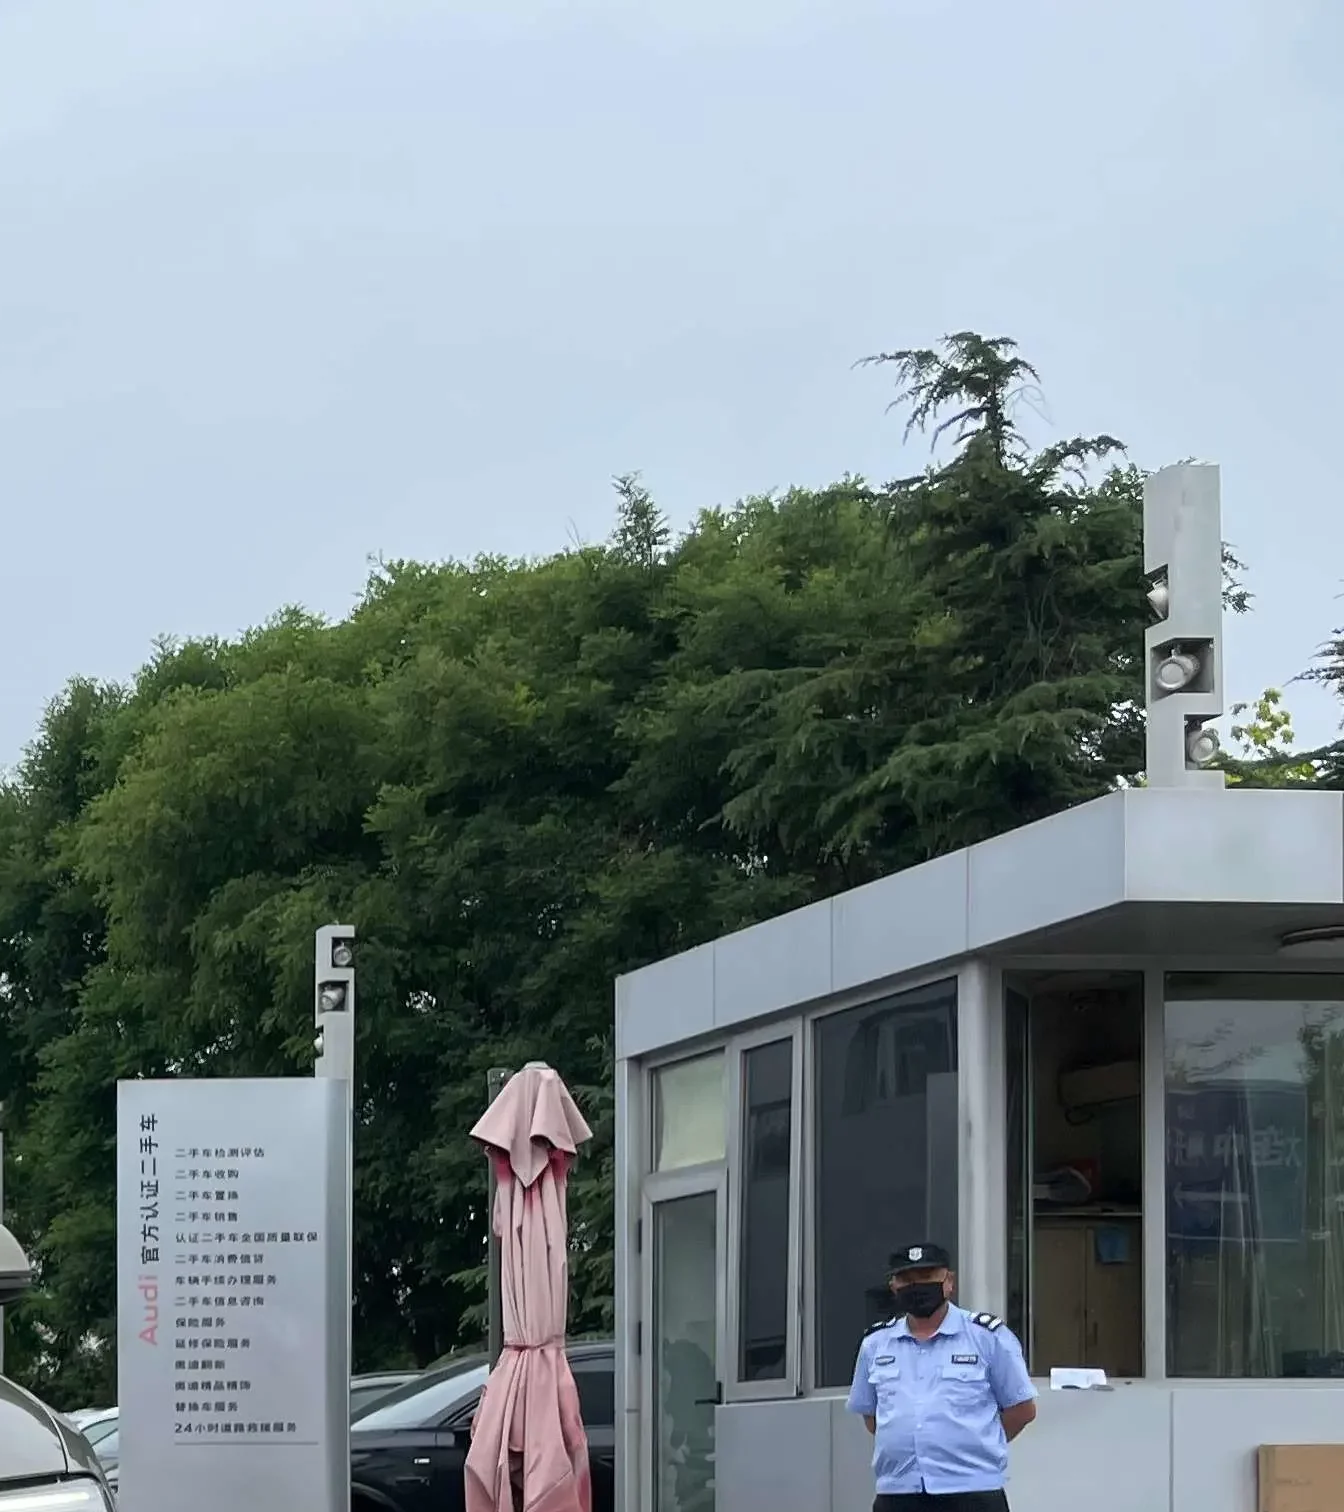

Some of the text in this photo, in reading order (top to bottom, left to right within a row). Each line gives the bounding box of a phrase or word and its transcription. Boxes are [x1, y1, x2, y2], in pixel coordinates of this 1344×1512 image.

[174, 1169, 239, 1180] 二手车收购
[138, 1113, 160, 1346] Audi 官方认证二手车
[175, 1317, 226, 1328] 保险服务
